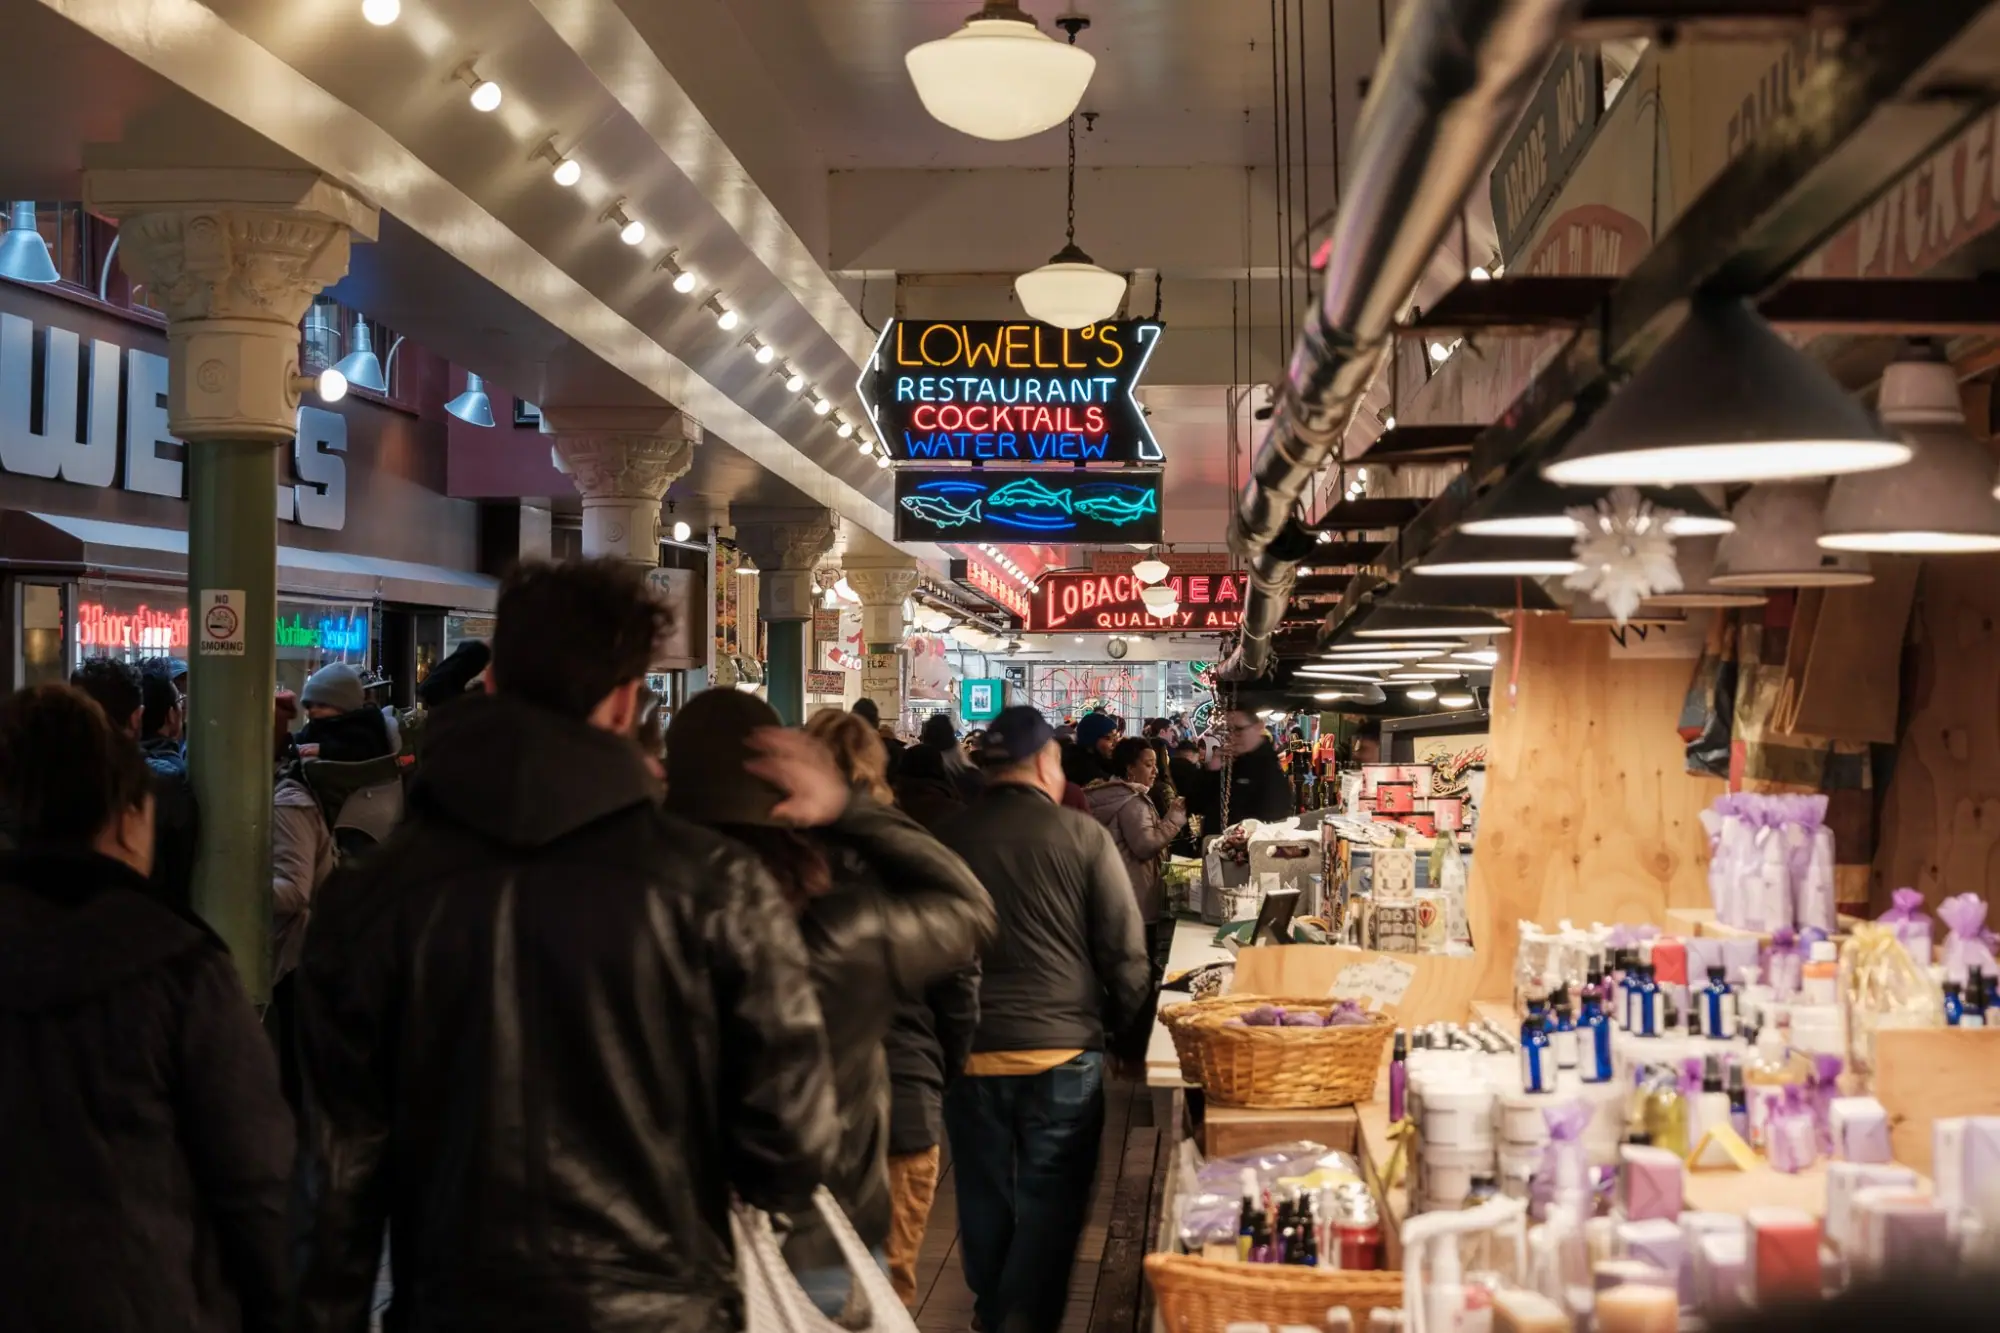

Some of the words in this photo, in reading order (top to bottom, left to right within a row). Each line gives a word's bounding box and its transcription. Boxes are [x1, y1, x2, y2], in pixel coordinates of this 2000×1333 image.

[1505, 114, 1547, 236] ARCADE
[897, 322, 1123, 368] LOWELL'S
[897, 376, 1117, 403] RESTAURANT
[913, 404, 1105, 432] COCKTAILS
[904, 431, 1019, 458] WATER
[1028, 432, 1109, 459] VIEW
[214, 595, 229, 604] NO
[79, 604, 91, 644] 3
[1097, 612, 1193, 629] QUALITY
[201, 640, 244, 652] SMOKING
